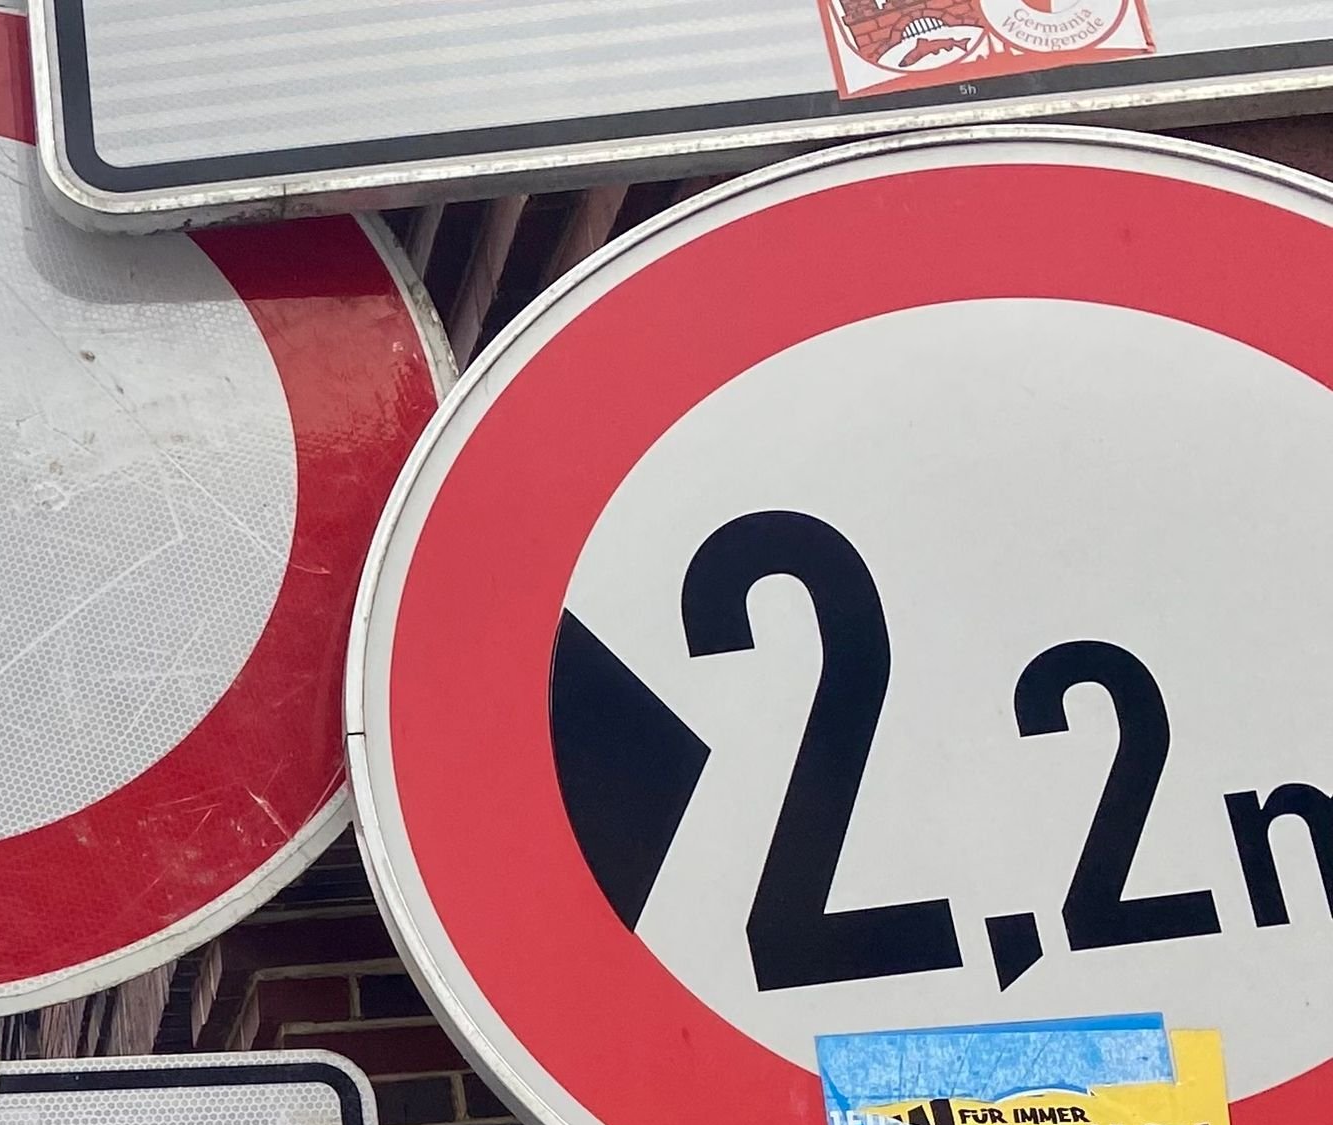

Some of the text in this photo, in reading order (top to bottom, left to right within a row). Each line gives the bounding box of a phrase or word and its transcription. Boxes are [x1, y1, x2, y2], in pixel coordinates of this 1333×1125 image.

[1001, 15, 1106, 50] Wernigerode
[1013, 7, 1093, 34] Germania
[958, 1106, 1091, 1124] FÜR IMMER
